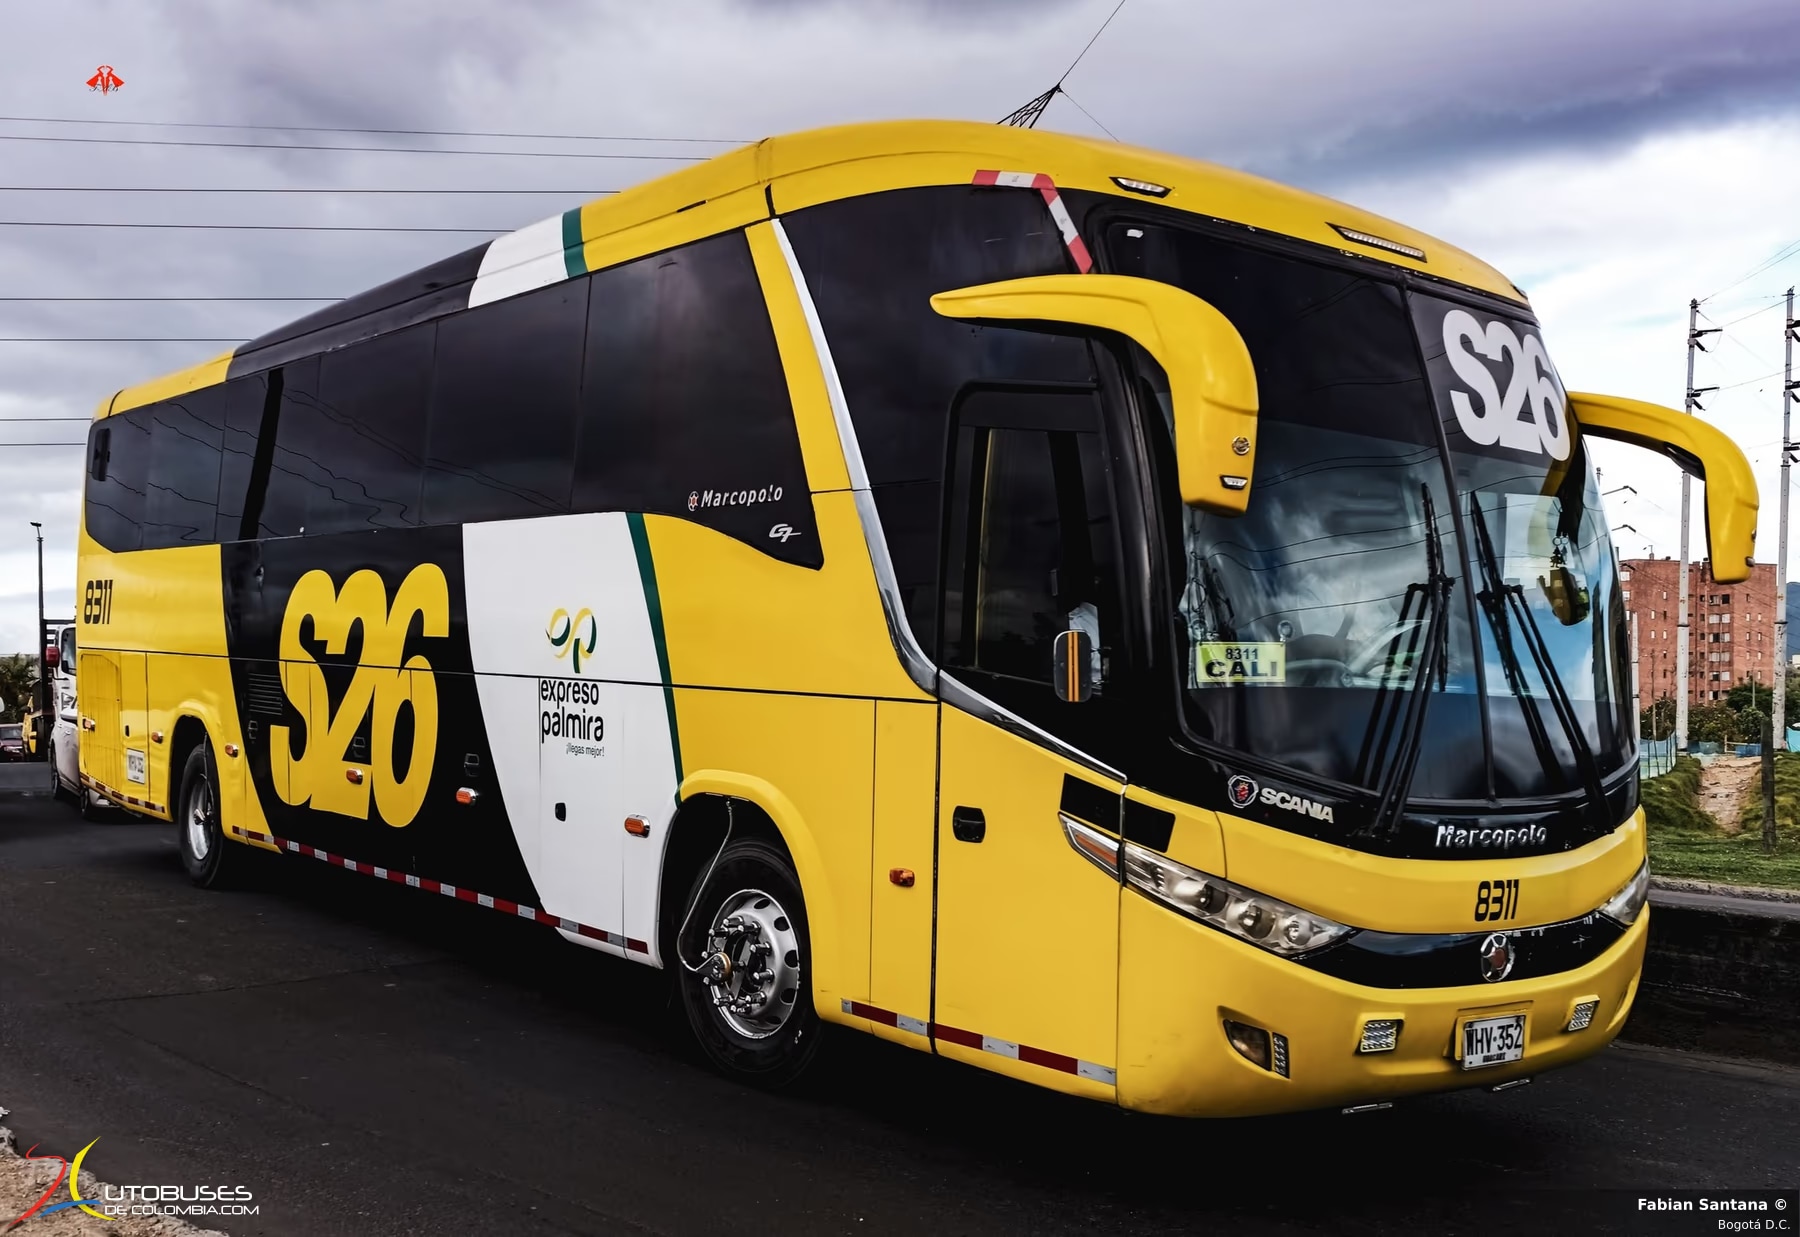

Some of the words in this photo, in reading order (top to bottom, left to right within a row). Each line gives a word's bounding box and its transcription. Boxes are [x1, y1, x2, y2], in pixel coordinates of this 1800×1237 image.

[1442, 309, 1571, 462] S26
[700, 484, 783, 508] Marcopolo
[83, 579, 114, 625] 8311
[1205, 661, 1278, 677] CALI
[1225, 647, 1259, 660] 8311
[270, 562, 449, 828] S26
[540, 679, 600, 710] expreso
[541, 705, 604, 744] palmira
[1259, 787, 1335, 824] SCANIA
[1434, 824, 1548, 850] Marcopolo
[1474, 879, 1520, 923] 8311
